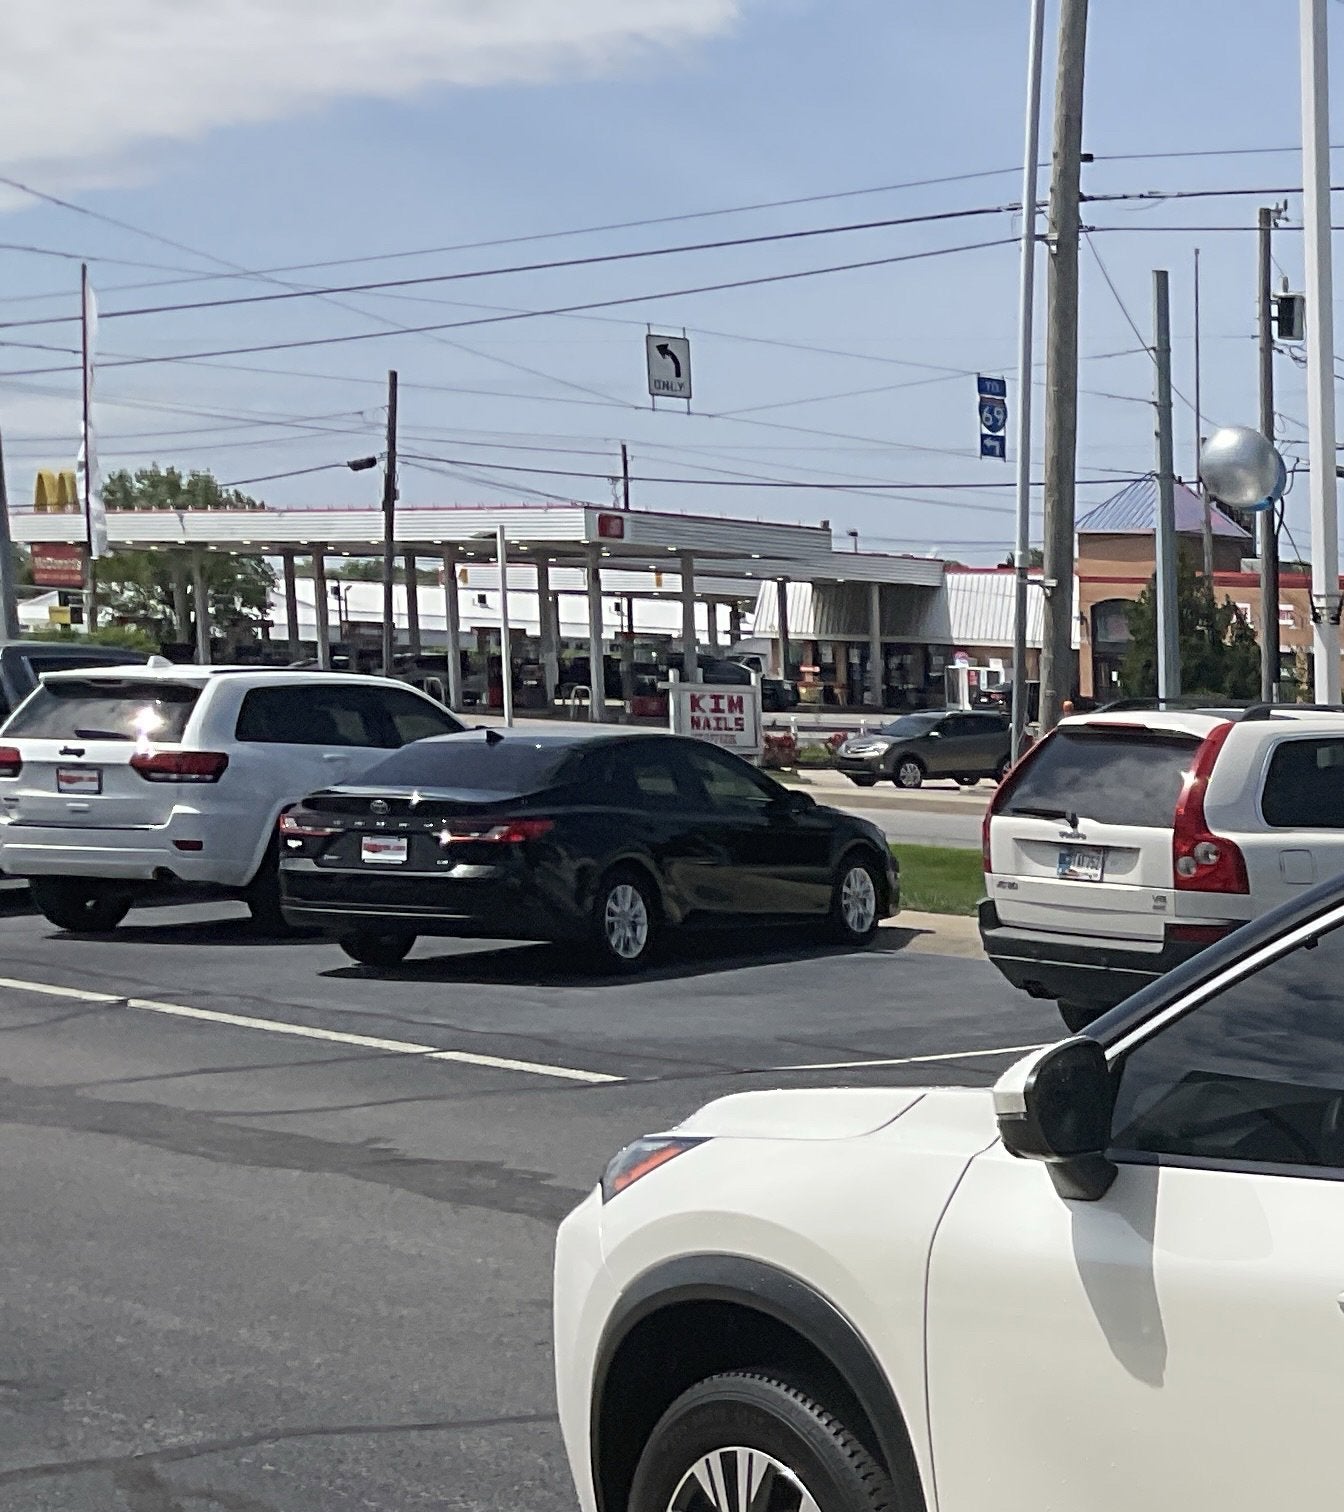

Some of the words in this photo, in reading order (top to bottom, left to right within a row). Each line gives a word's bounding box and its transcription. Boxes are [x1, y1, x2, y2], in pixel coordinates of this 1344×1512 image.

[654, 379, 685, 392] ONLY
[985, 381, 1000, 392] TO
[982, 406, 1004, 426] 69
[690, 694, 744, 714] KIM
[690, 716, 745, 731] NAILS
